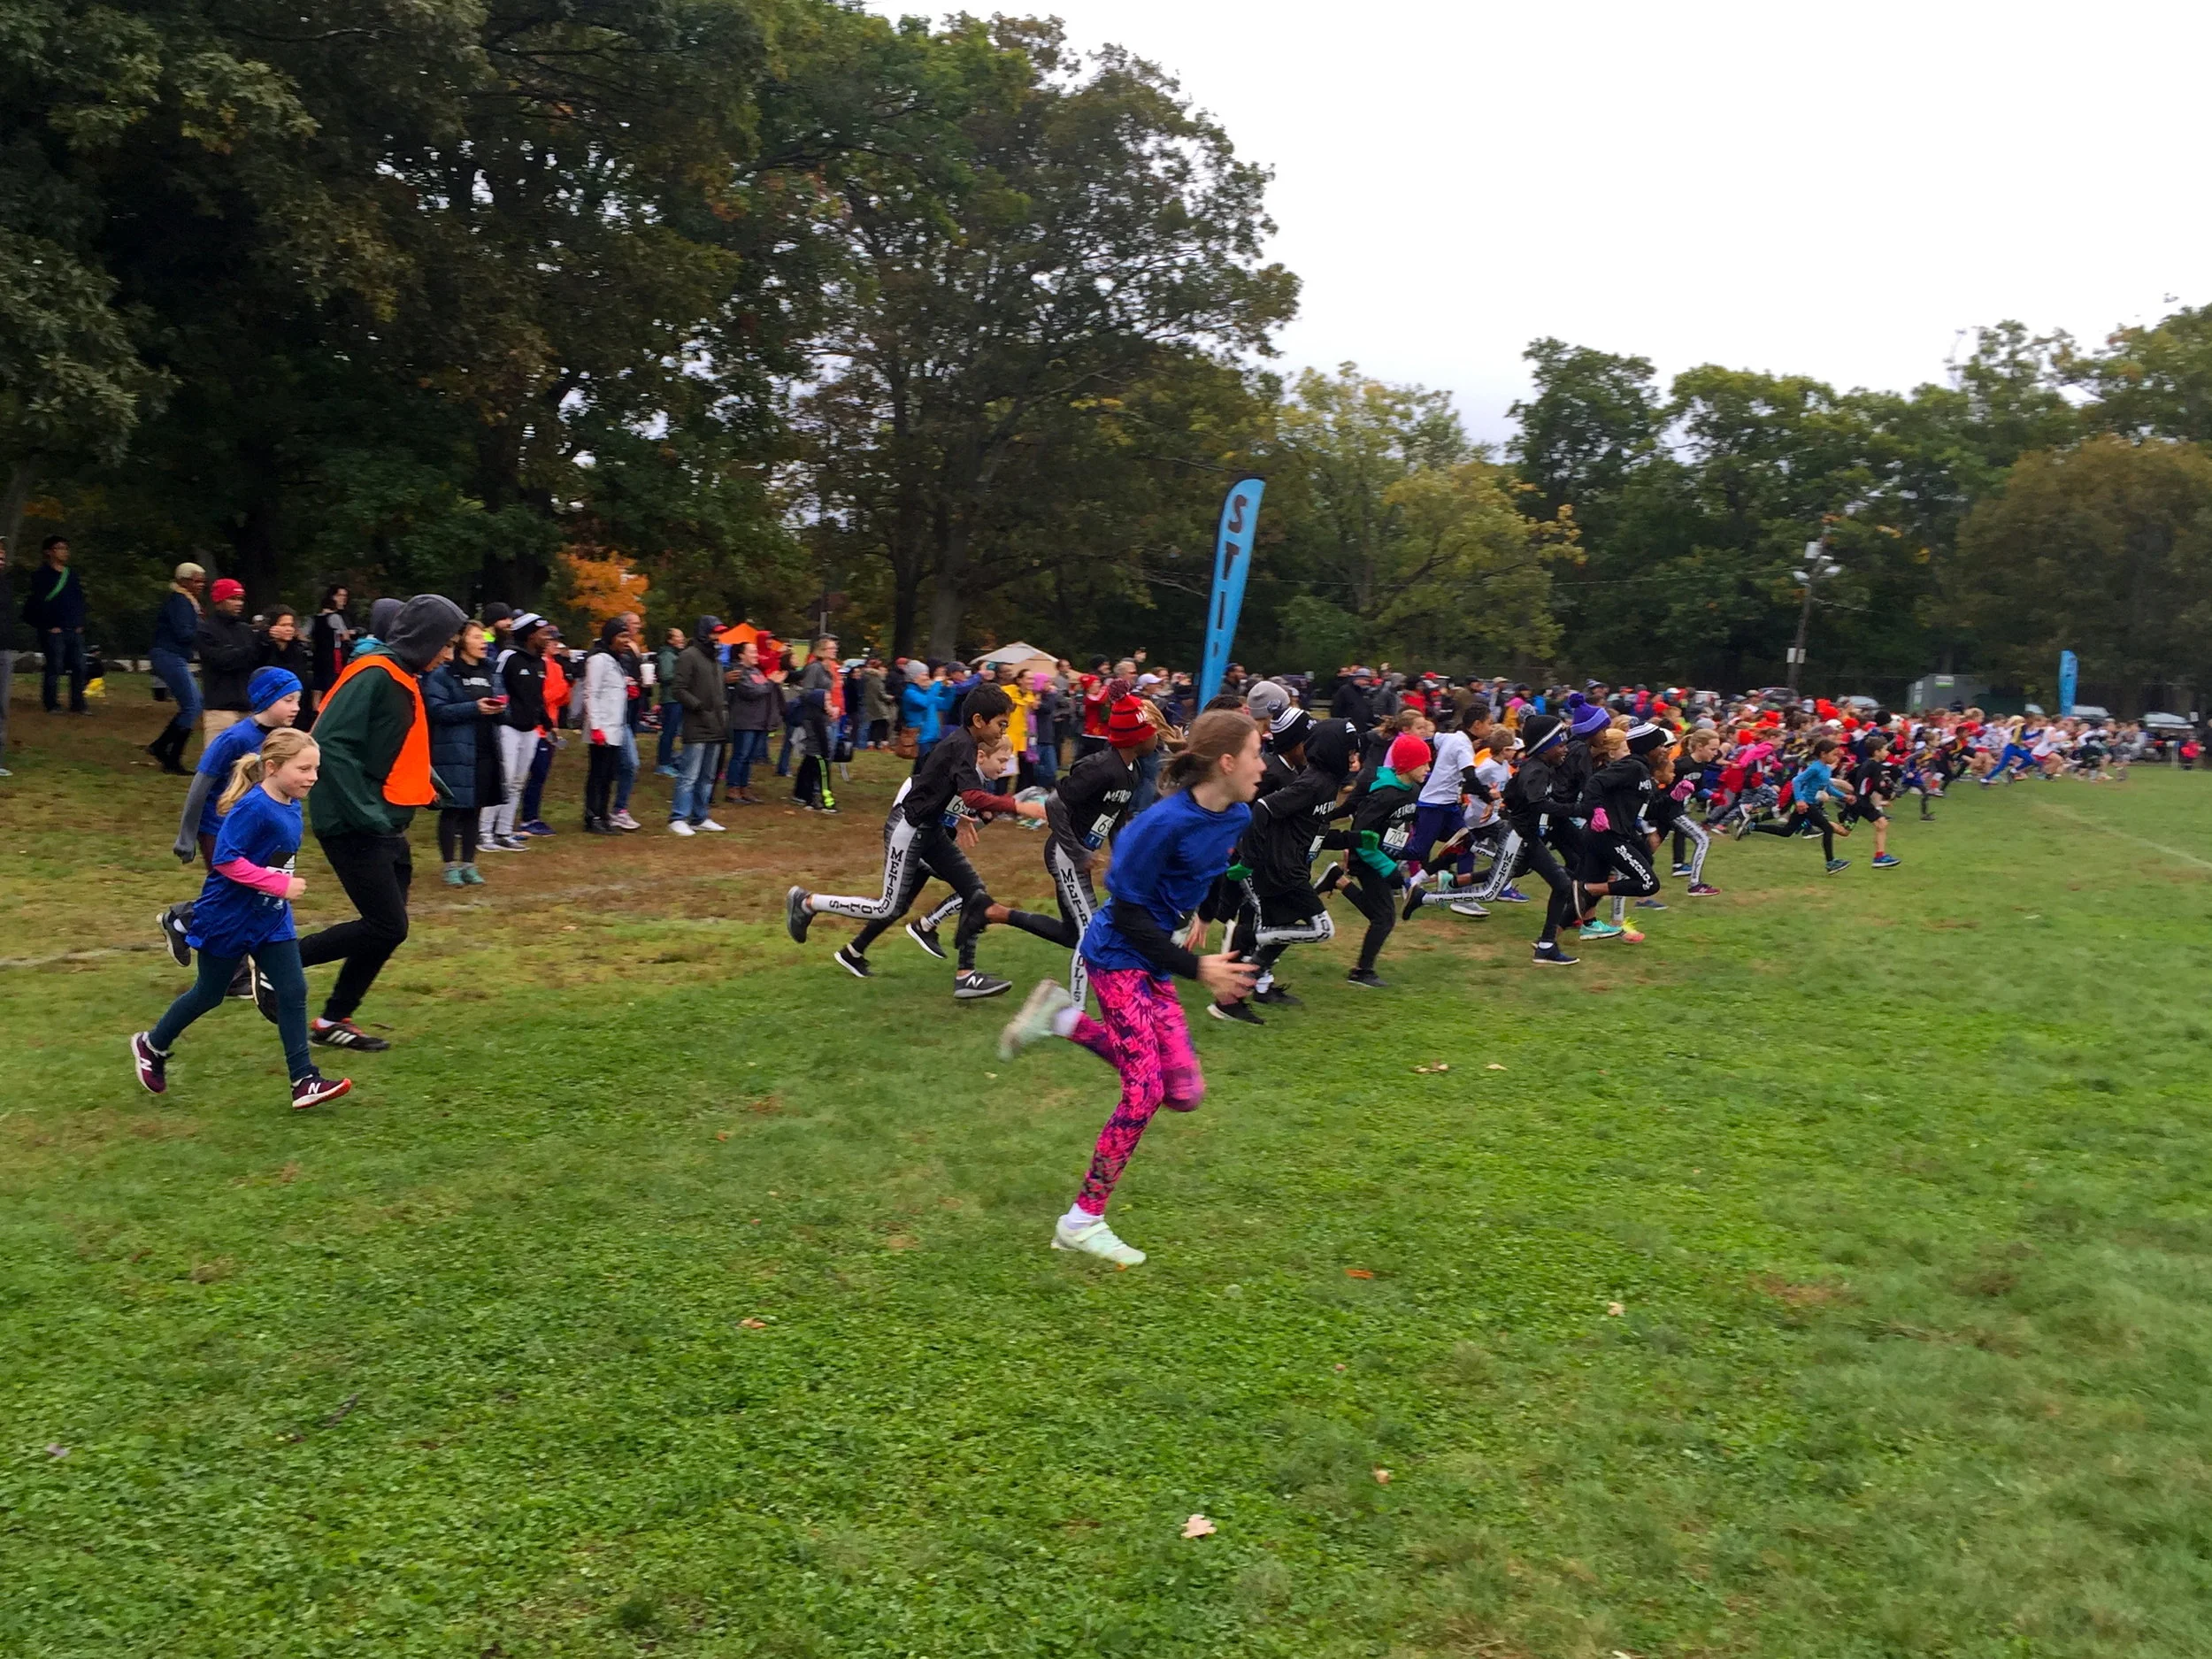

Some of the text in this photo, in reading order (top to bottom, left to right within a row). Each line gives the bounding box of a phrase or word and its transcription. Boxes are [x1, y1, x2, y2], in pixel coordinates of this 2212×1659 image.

[1388, 830, 1405, 844] 704
[829, 847, 904, 914] METROPOLIS
[1434, 851, 1514, 902] METROPOLIS
